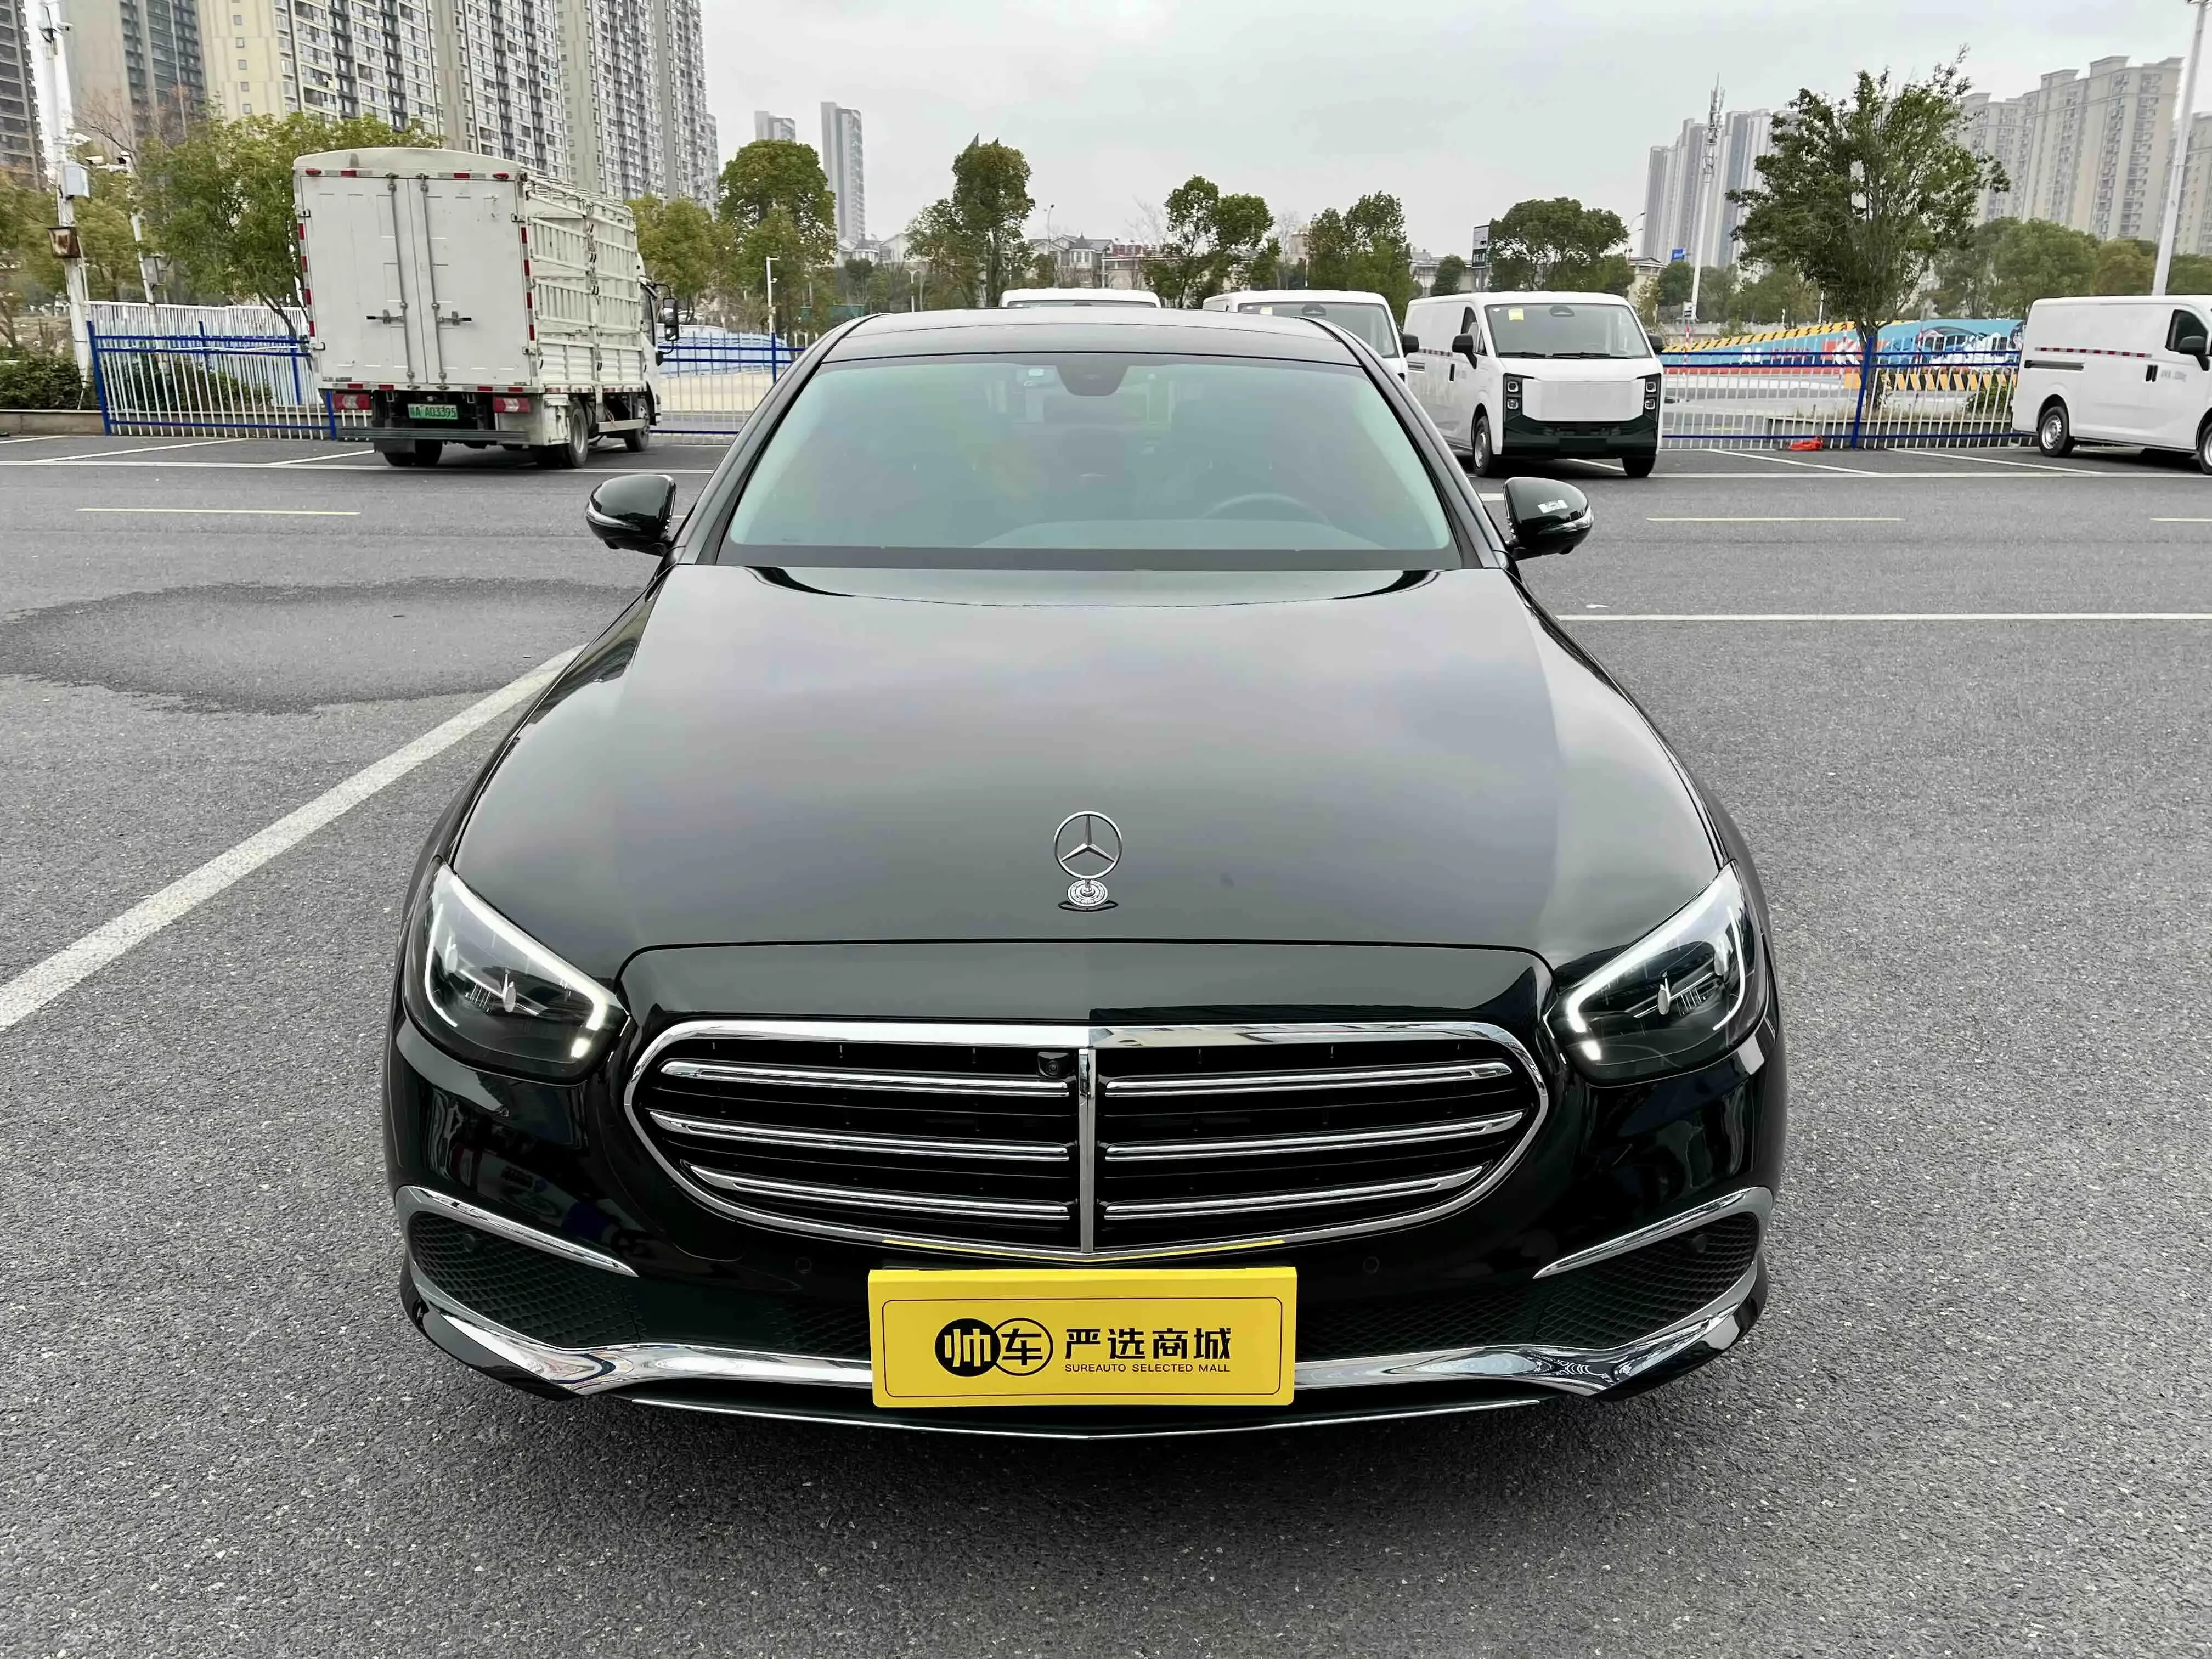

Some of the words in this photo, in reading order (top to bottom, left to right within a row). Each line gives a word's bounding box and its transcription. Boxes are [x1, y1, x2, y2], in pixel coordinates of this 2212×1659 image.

[944, 1328, 1043, 1367] 帅车
[1065, 1328, 1231, 1359] 严选商城
[1065, 1364, 1126, 1373] SUREAUTO
[1132, 1364, 1193, 1372] SELECTED
[1199, 1364, 1231, 1372] MALL
